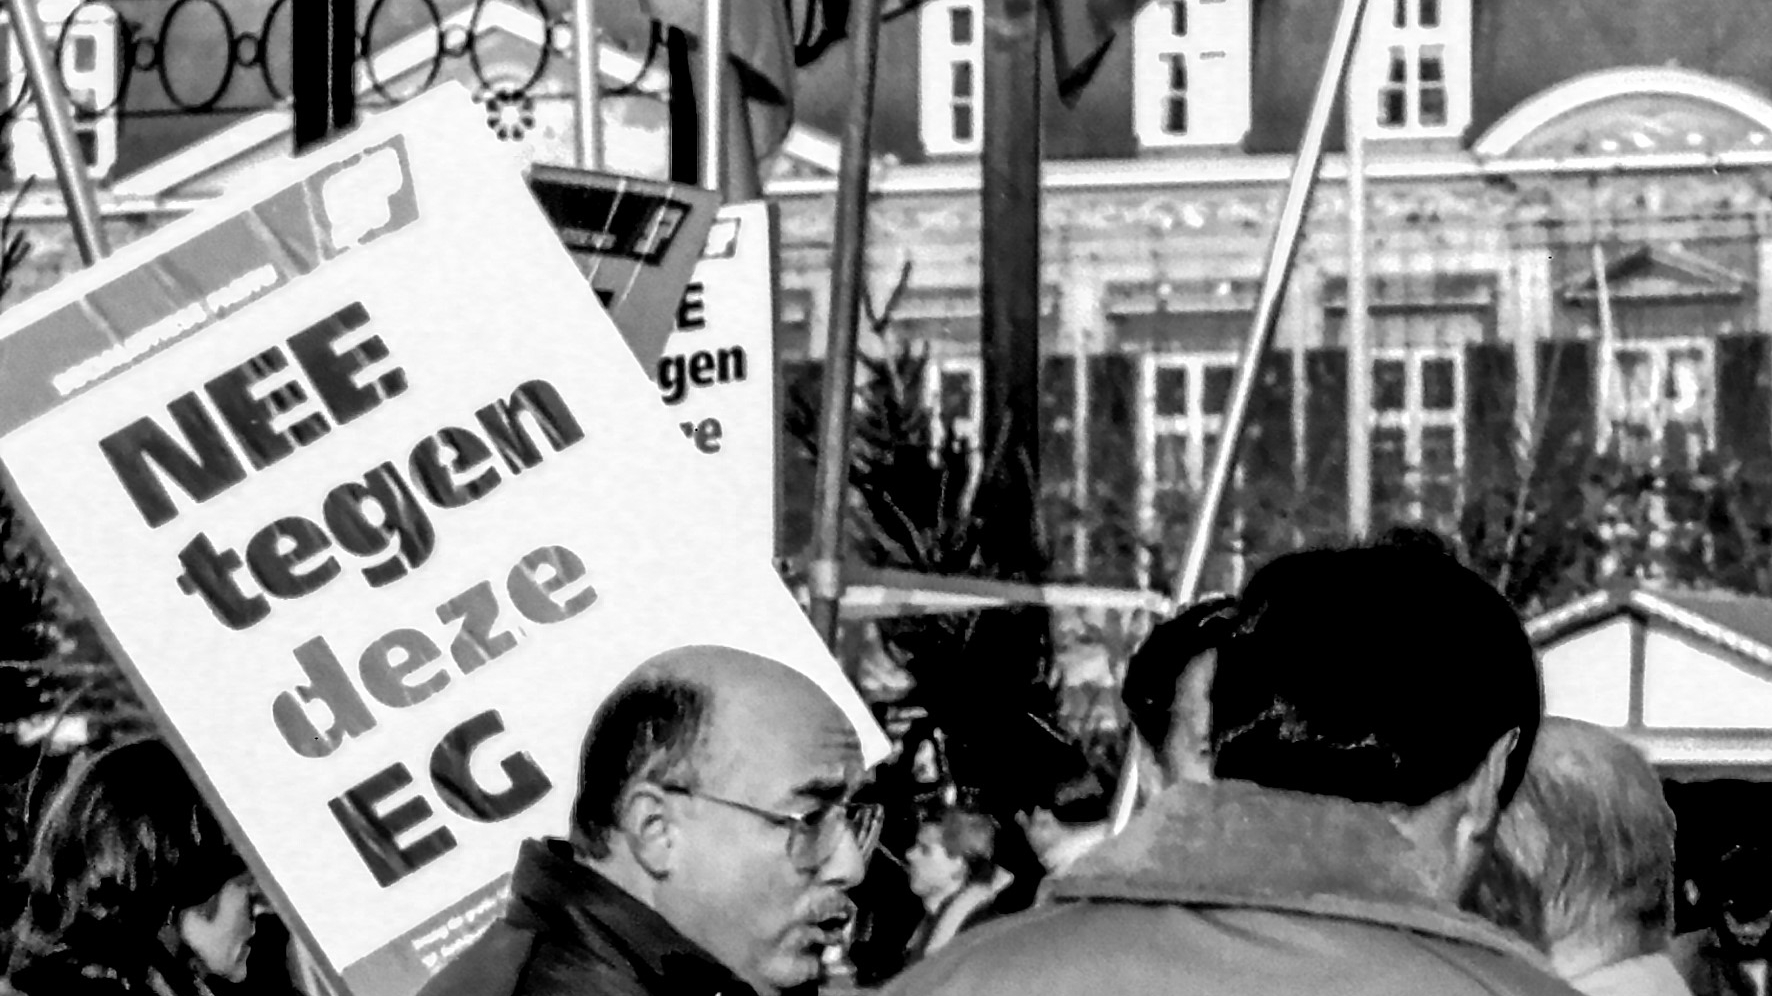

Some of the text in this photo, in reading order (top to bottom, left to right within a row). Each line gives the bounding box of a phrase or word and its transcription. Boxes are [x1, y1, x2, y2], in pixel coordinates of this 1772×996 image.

[98, 301, 409, 530] NEE
[656, 345, 748, 406] gen
[177, 377, 586, 632] tegen
[271, 544, 599, 759] deze
[327, 709, 554, 889] EG
